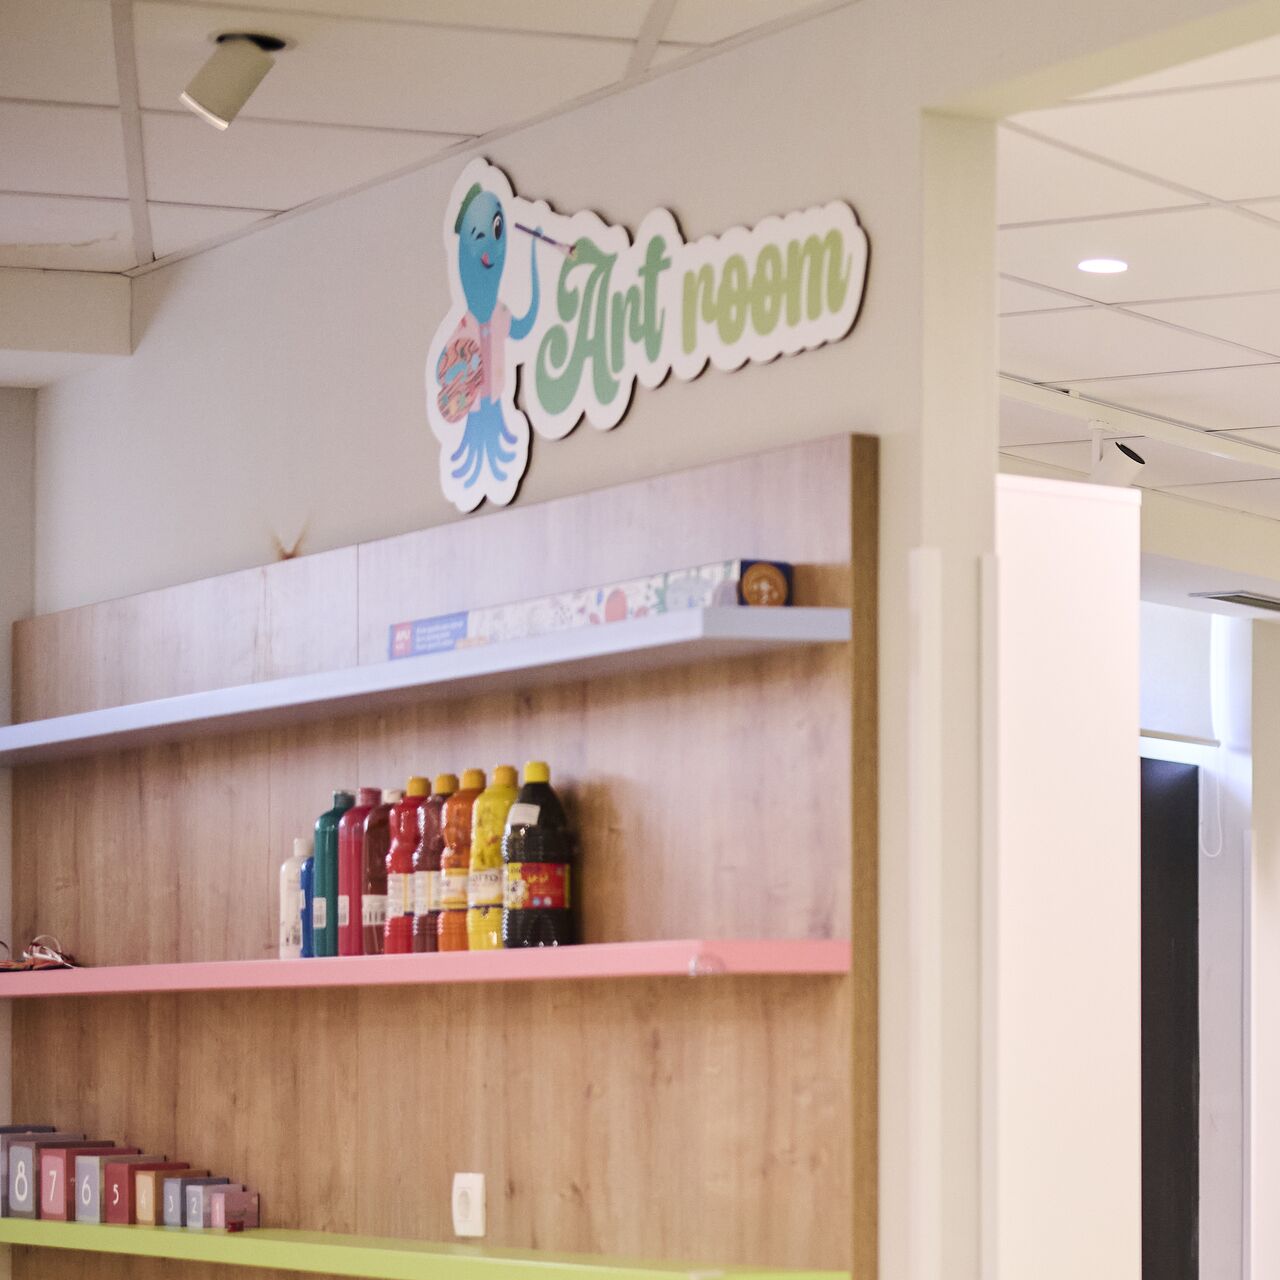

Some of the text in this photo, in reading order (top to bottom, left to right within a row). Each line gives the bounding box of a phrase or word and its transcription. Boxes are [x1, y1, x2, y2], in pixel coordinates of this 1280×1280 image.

[535, 228, 853, 415] Art room
[15, 1160, 28, 1202] 8
[49, 1170, 57, 1201] 7
[82, 1175, 91, 1206] 6
[112, 1184, 119, 1205] 5
